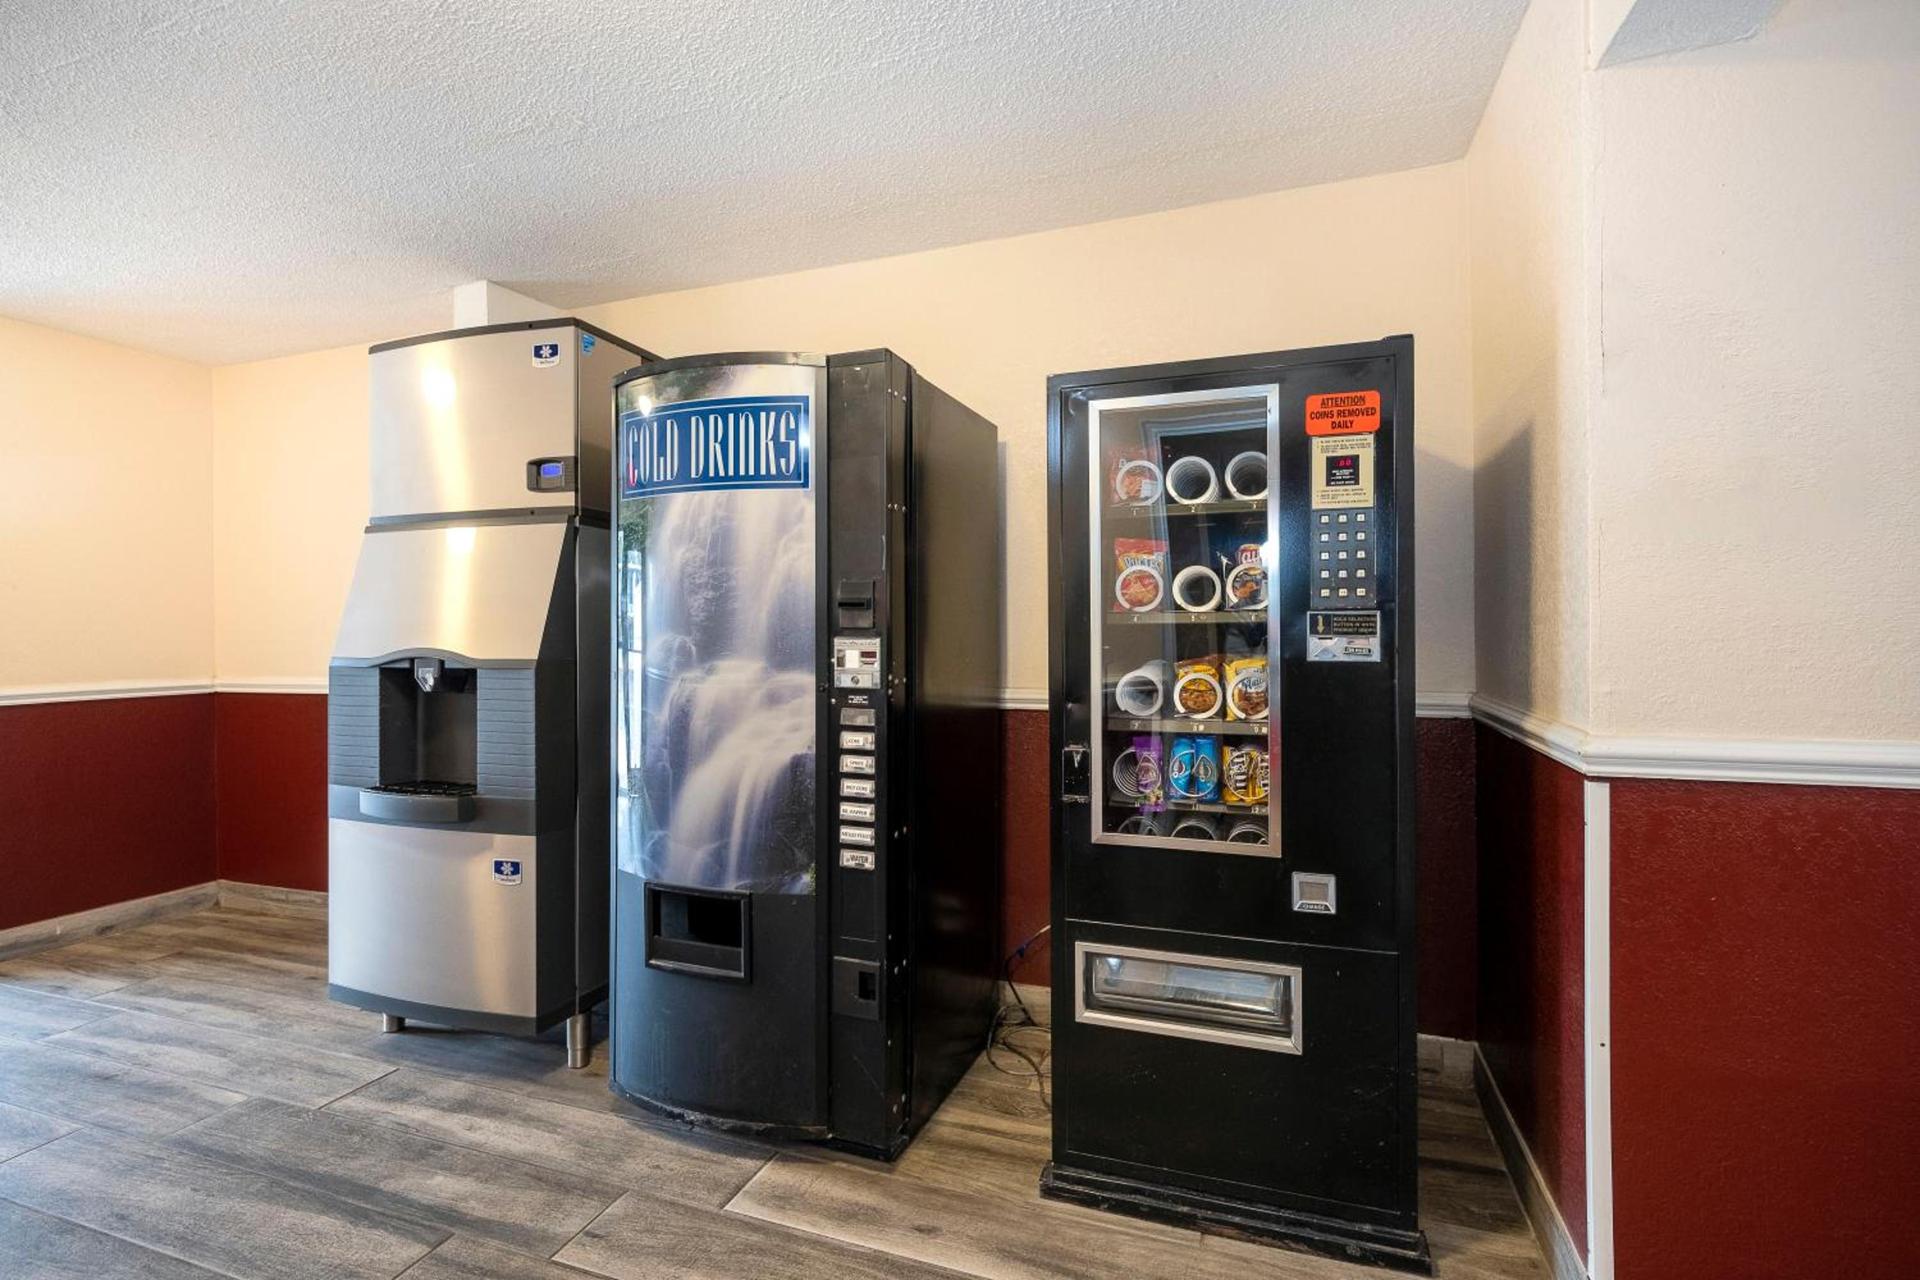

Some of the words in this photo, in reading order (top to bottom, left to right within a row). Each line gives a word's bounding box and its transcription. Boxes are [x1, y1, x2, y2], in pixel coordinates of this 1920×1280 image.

[1320, 395, 1366, 408] ATTENTION
[1310, 409, 1335, 420] COINS
[1337, 407, 1377, 419] REMOVED
[1331, 420, 1354, 430] DAILY
[629, 418, 679, 487] COLD
[690, 410, 796, 478] DRINKS
